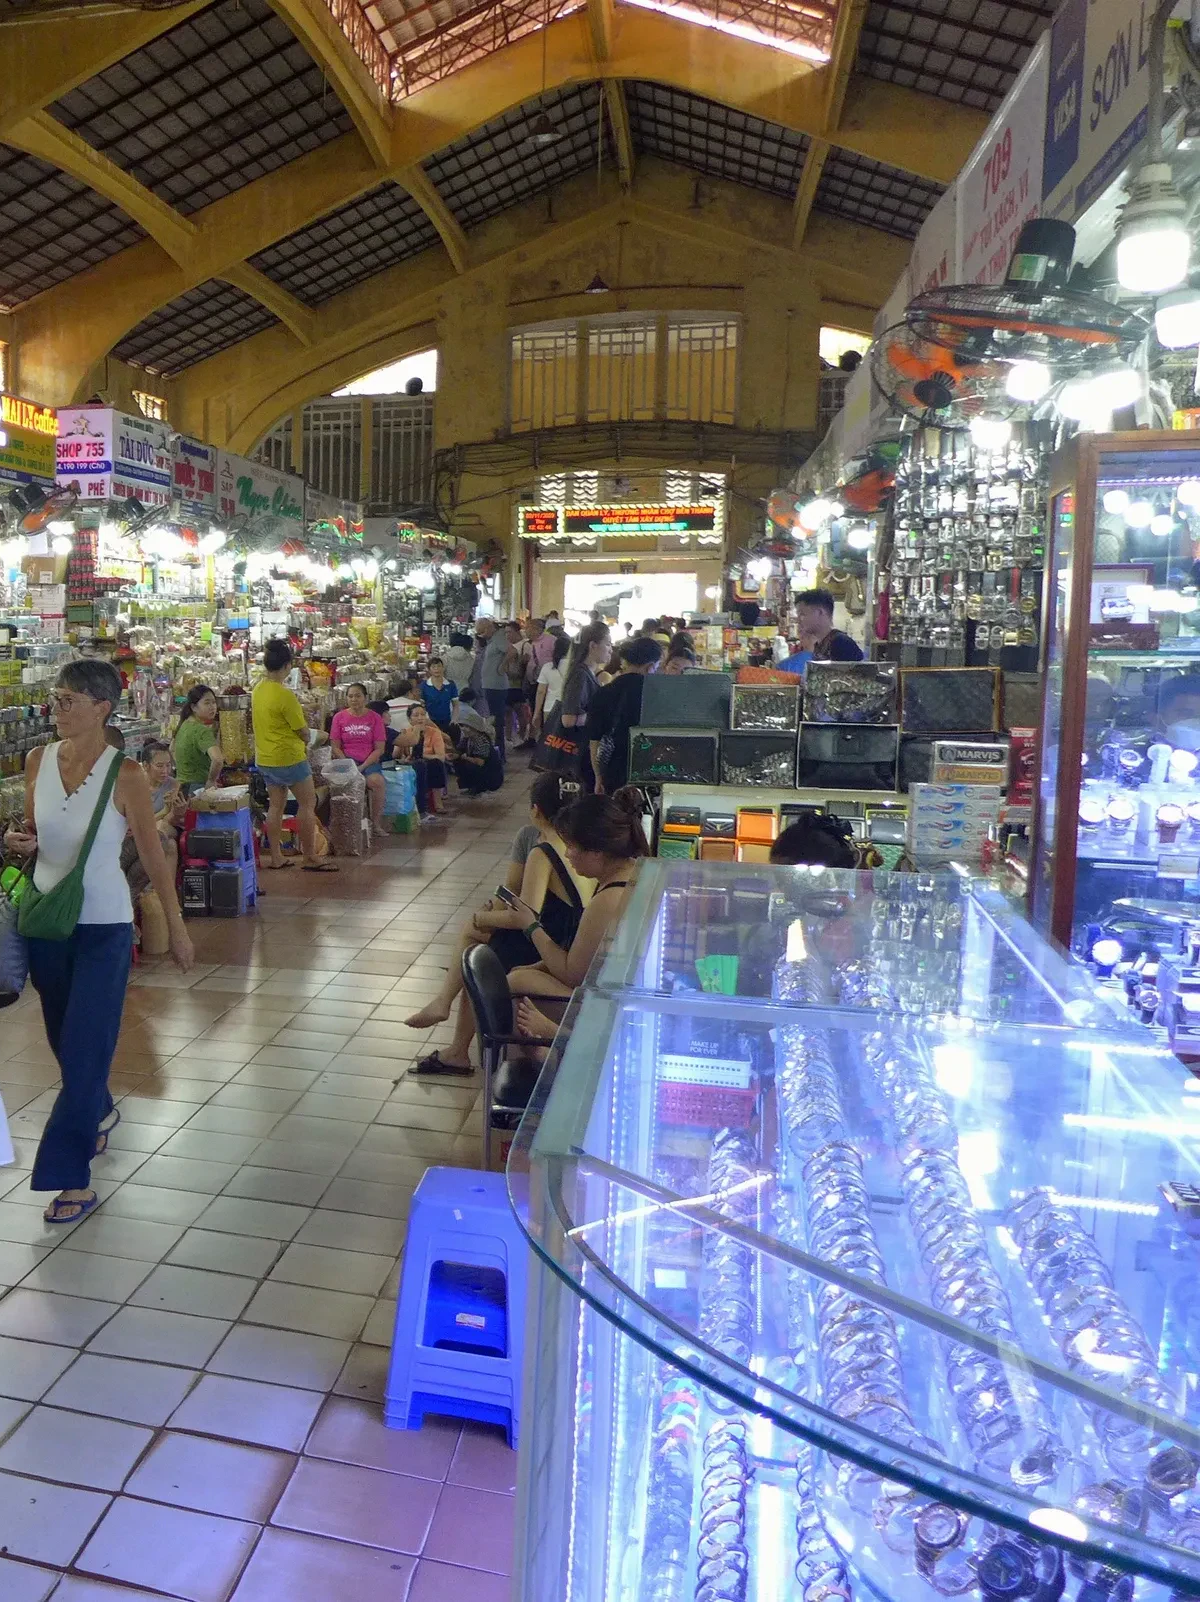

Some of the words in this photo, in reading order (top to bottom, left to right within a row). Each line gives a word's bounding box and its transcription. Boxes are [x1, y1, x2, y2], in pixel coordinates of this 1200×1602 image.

[984, 127, 1012, 212] 709
[56, 442, 82, 458] SHOP
[85, 442, 105, 457] 755
[87, 481, 105, 496] PHÊ
[956, 749, 1000, 761] MARVIS
